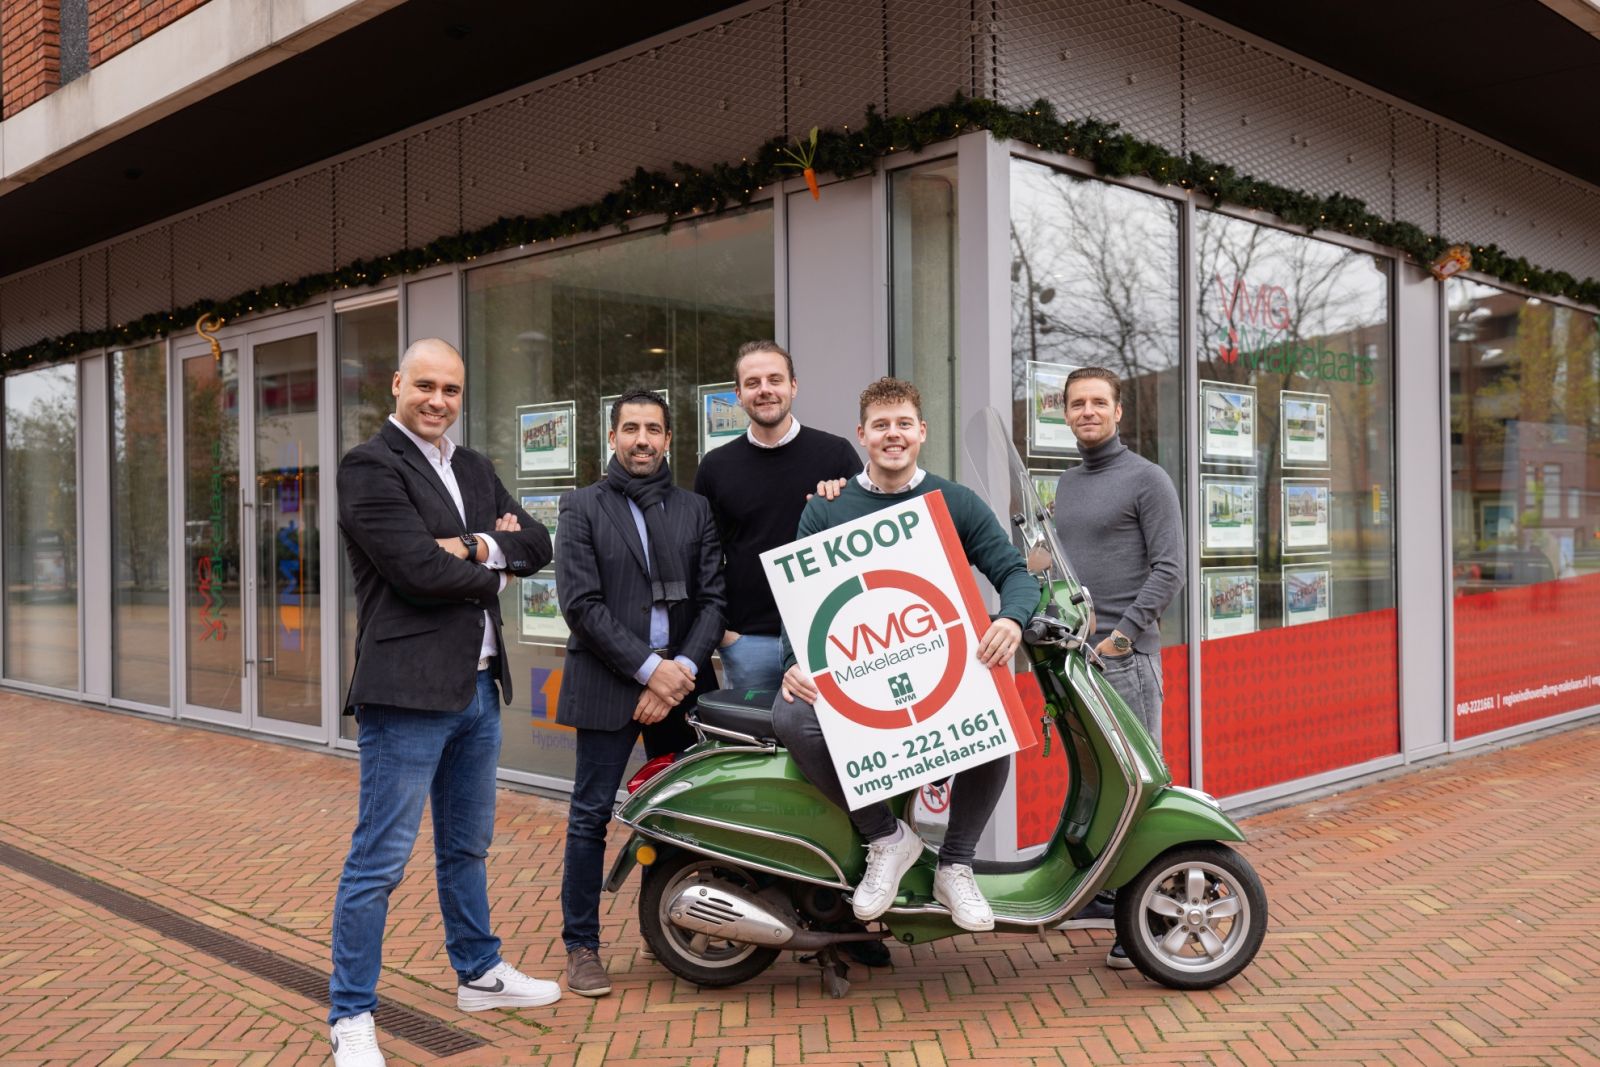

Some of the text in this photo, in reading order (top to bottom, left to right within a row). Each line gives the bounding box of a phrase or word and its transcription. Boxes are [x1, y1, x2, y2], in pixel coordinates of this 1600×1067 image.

[1216, 272, 1291, 330] VMG
[1239, 324, 1375, 386] Makelaars
[773, 510, 920, 584] TE KOOP
[199, 555, 213, 641] VMG
[828, 603, 939, 662] VMG
[834, 634, 945, 685] Makelaars.nl
[895, 692, 917, 706] NVM
[845, 750, 888, 780] 040
[902, 730, 945, 760] 222
[947, 708, 1000, 742] 1661
[853, 728, 1008, 797] vmg-makelaars.nl
